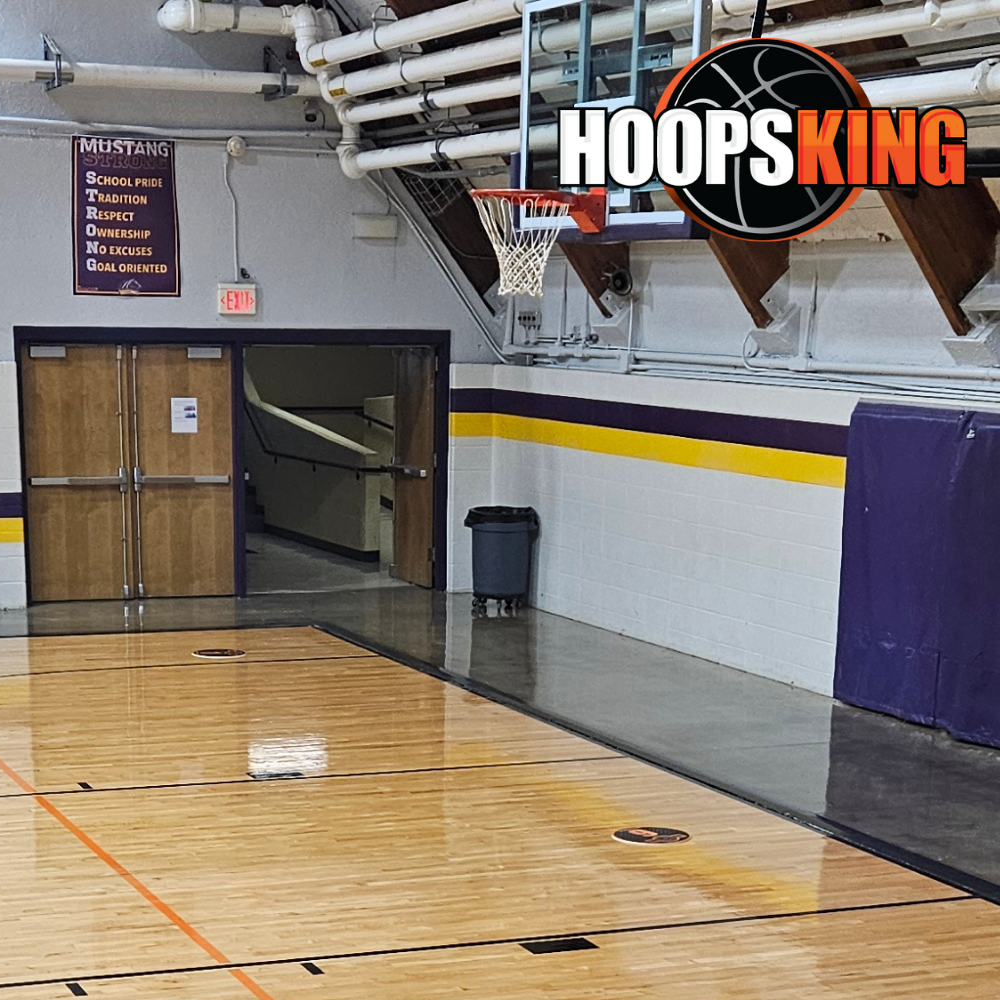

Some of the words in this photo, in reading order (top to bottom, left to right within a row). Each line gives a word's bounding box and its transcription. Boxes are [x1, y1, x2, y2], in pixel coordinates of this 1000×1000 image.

[80, 137, 169, 157] MUSTANG
[83, 153, 167, 169] STRONG
[85, 171, 132, 187] SCHOOL
[135, 177, 163, 188] PRIDE
[85, 189, 147, 205] TRADITION
[85, 206, 135, 222] RESPECT
[85, 224, 151, 239] OWNERSHIP
[85, 241, 107, 255] NO
[109, 246, 153, 256] EXCUSES
[86, 258, 117, 273] GOAL
[118, 263, 168, 273] ORIENTED
[226, 290, 250, 310] EXIT
